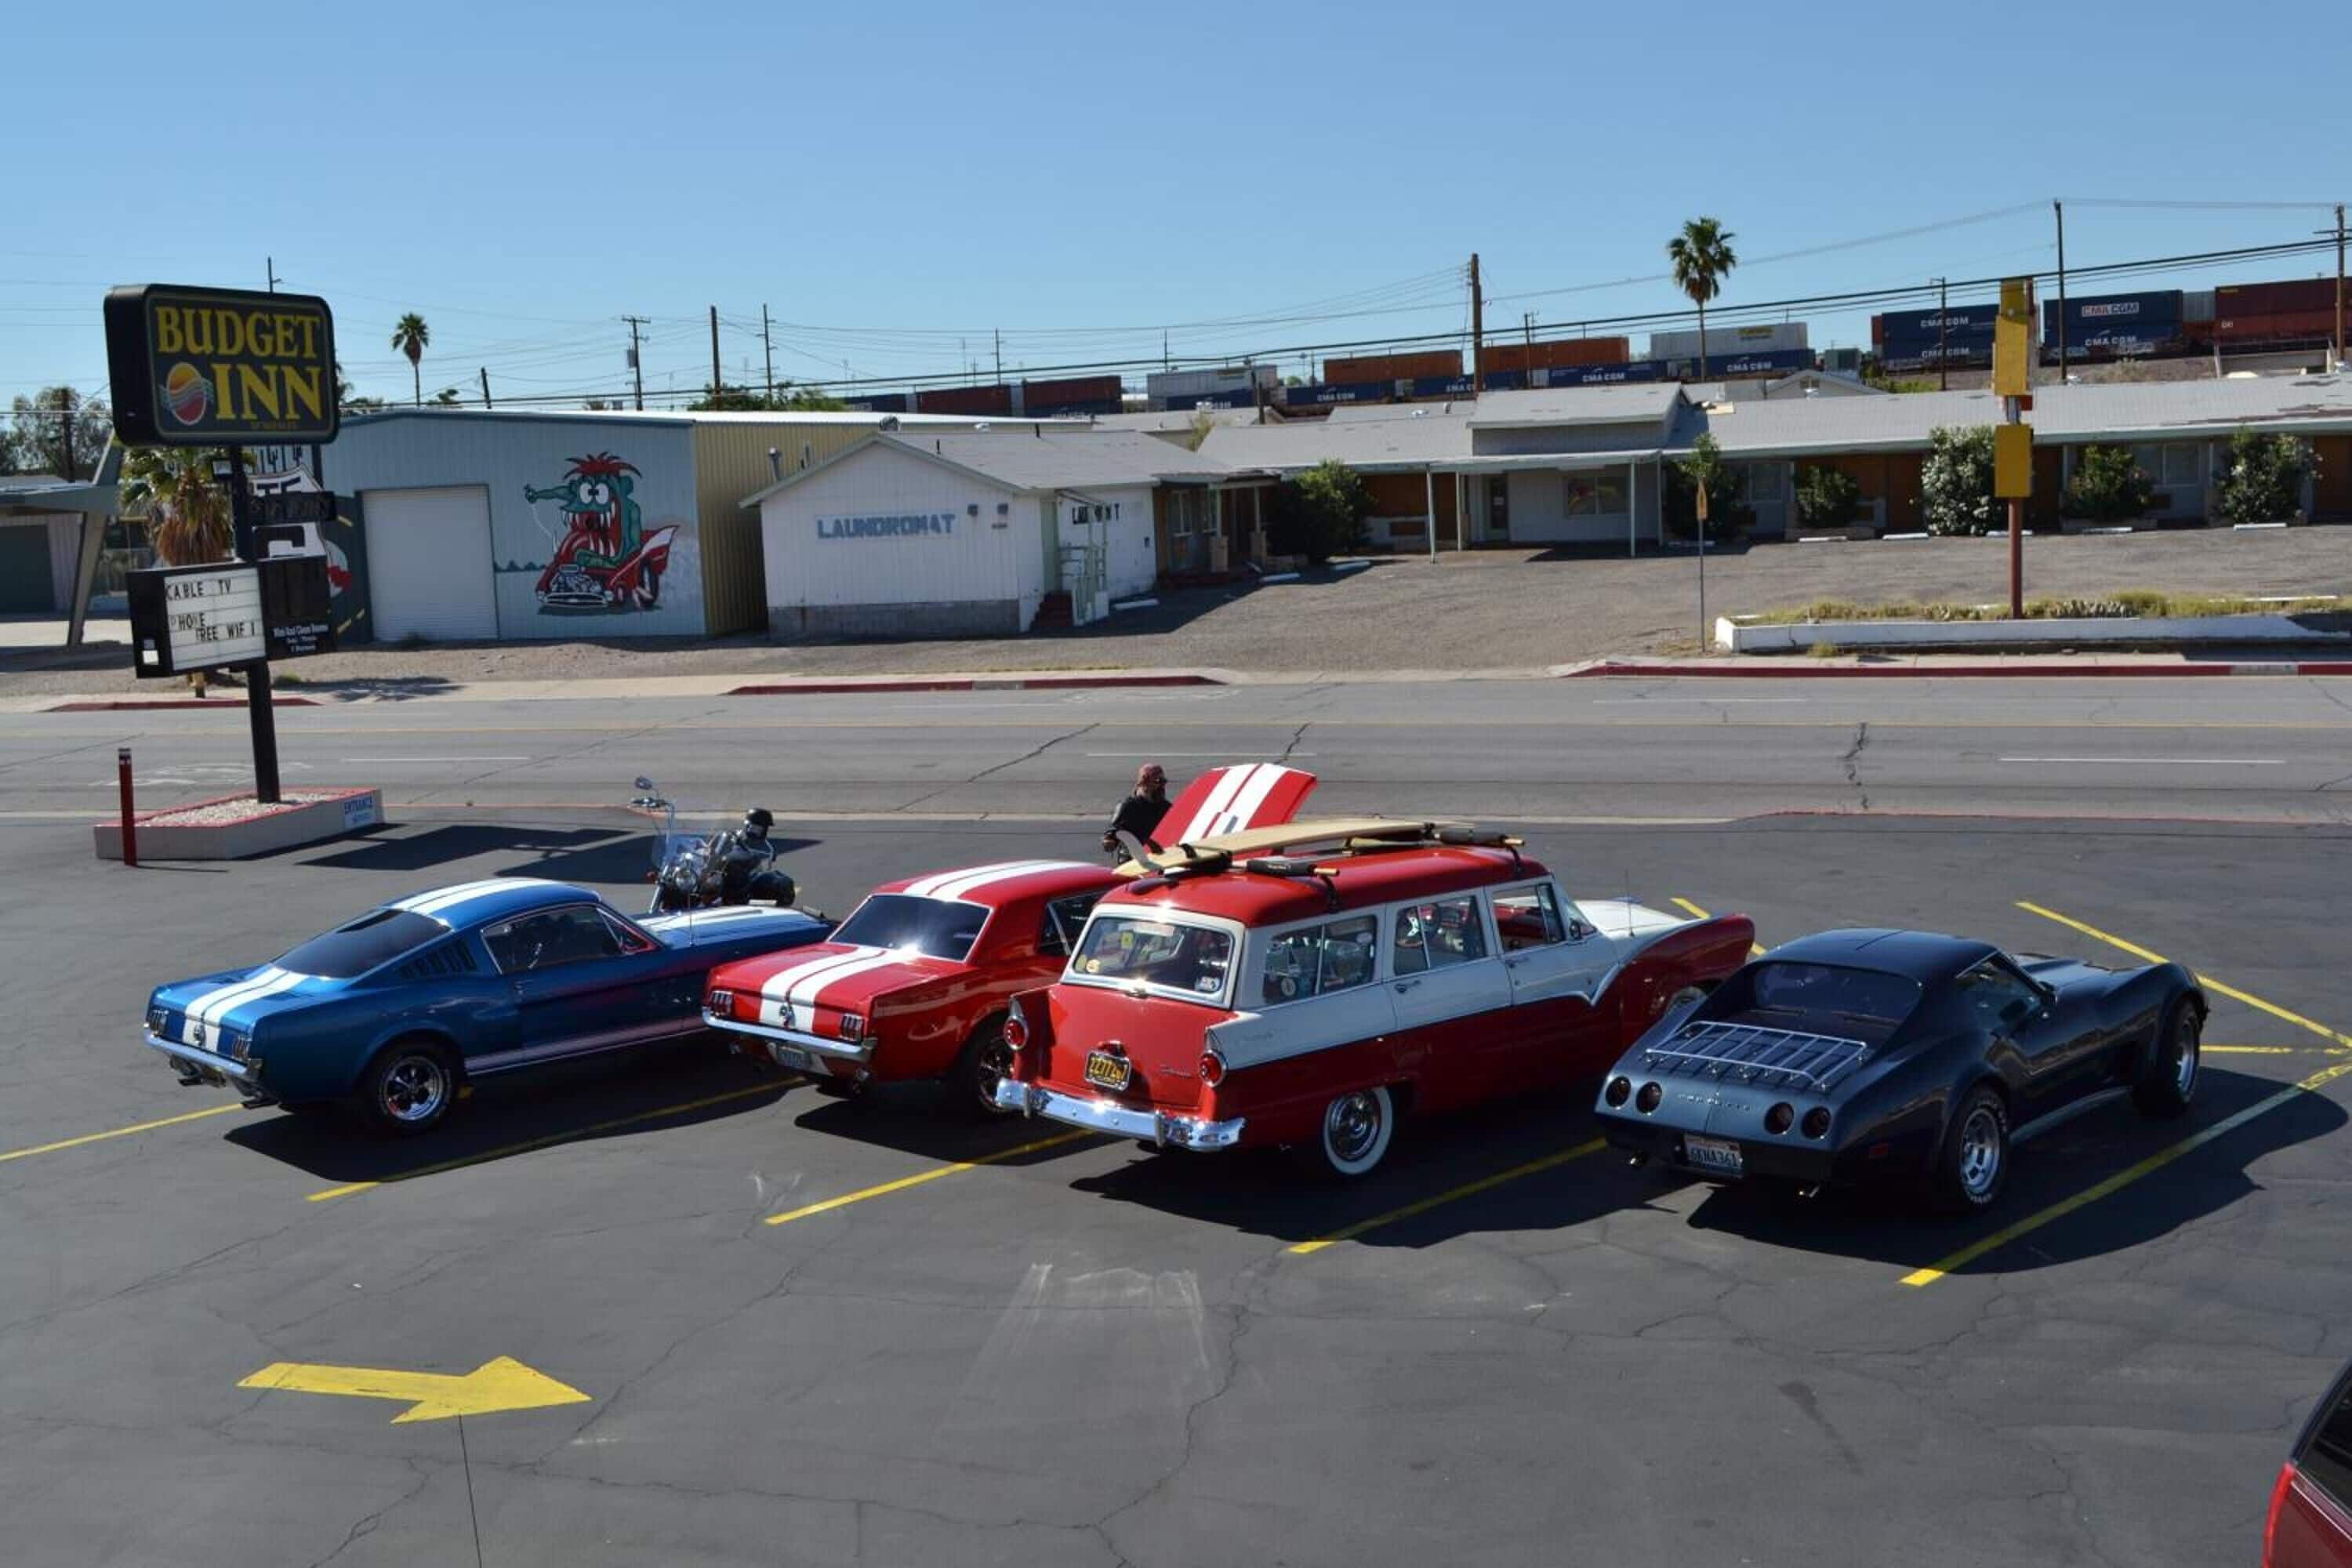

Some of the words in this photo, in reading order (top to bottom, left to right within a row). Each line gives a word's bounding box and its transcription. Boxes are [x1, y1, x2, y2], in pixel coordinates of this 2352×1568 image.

[156, 307, 321, 358] BUDGET
[212, 363, 322, 420] INN
[817, 514, 956, 539] LAUNDROMAT
[166, 581, 204, 601] CABLE
[218, 579, 232, 596] TV
[196, 626, 219, 643] FREE
